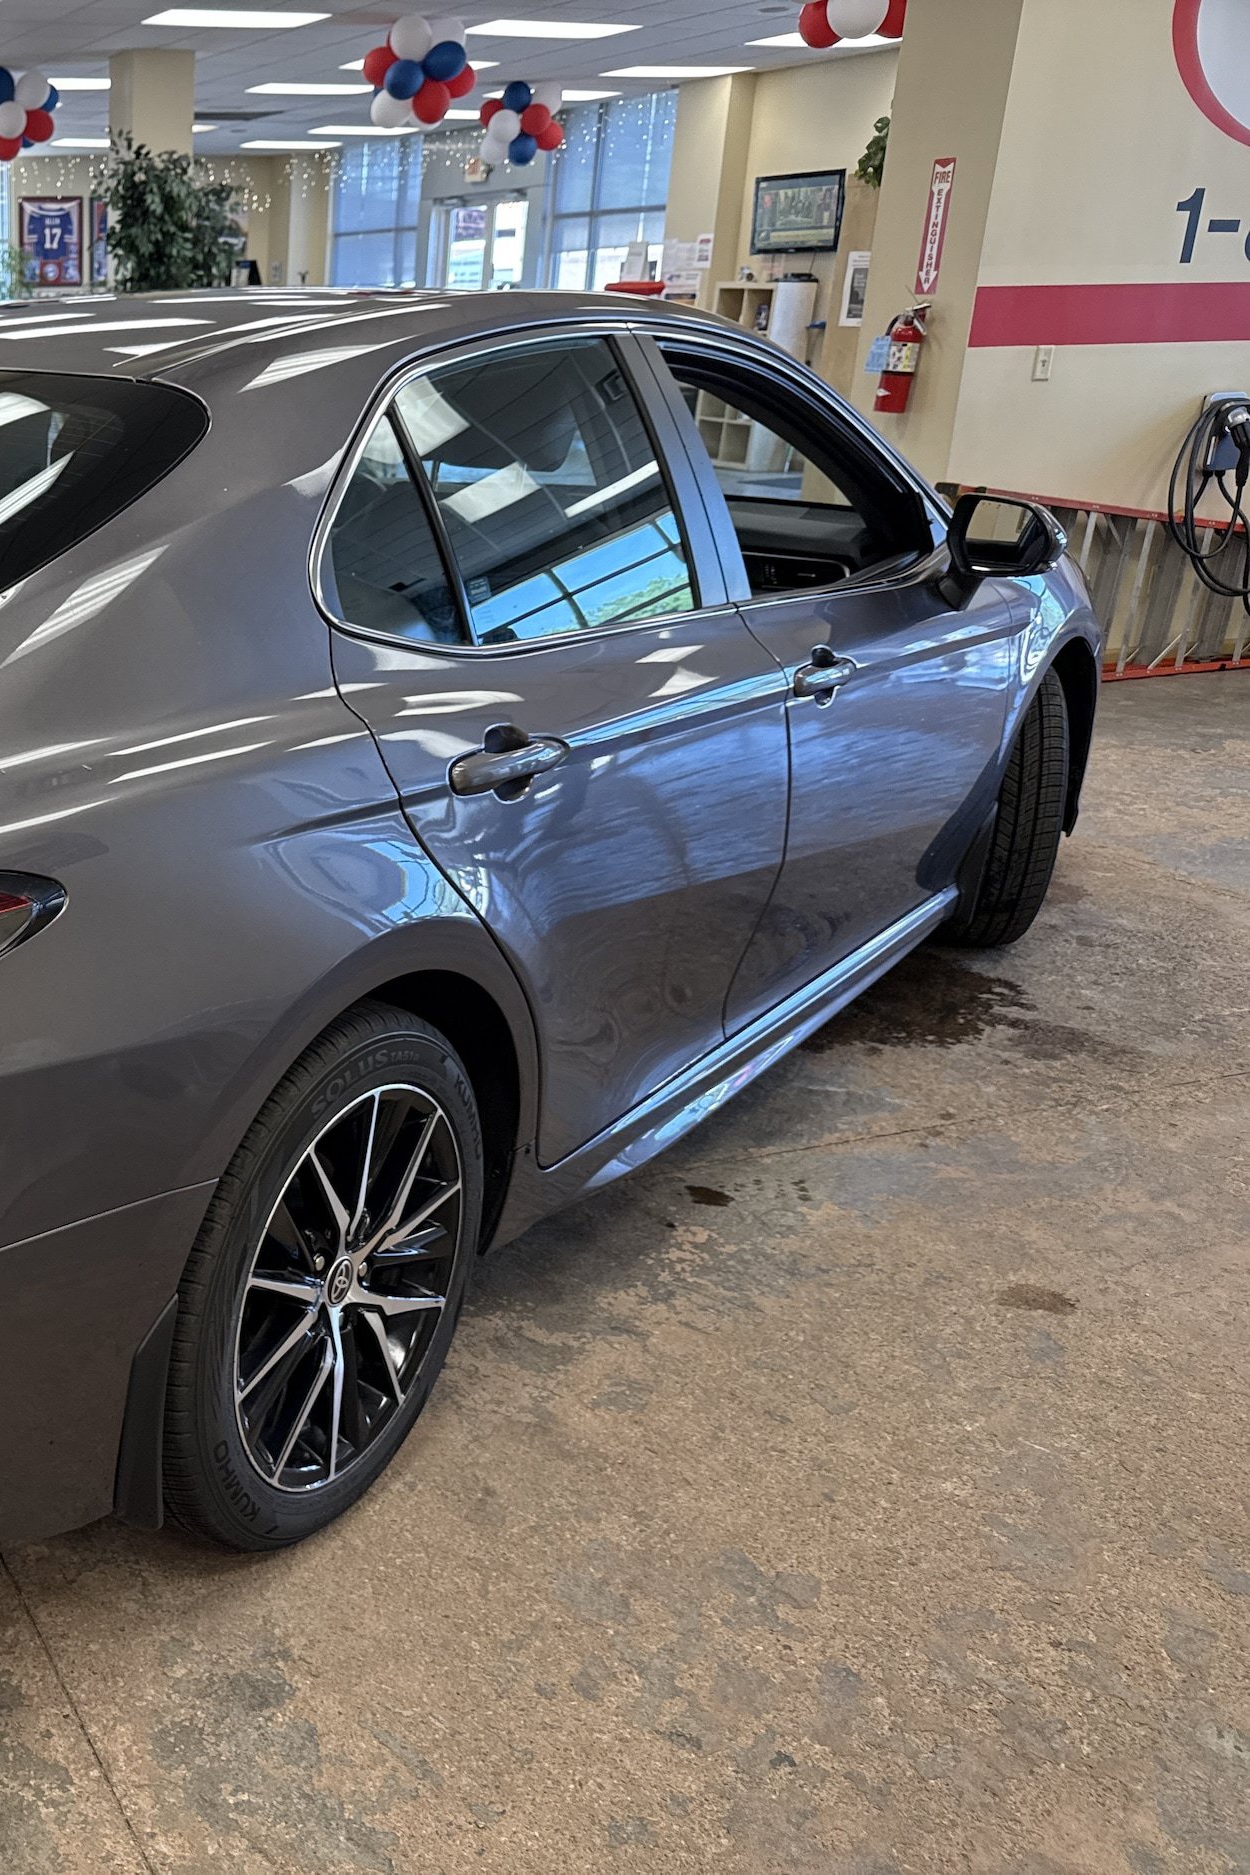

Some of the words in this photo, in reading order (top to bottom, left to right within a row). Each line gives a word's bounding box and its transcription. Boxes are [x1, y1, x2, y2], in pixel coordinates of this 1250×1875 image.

[934, 171, 951, 184] FIRE
[44, 227, 62, 250] 17
[924, 188, 943, 284] EXTINGUISHER
[1176, 187, 1250, 264] 1-
[310, 1049, 389, 1121] SOLUS
[454, 1073, 482, 1161] KUMHO
[213, 1439, 262, 1523] KUMHO
